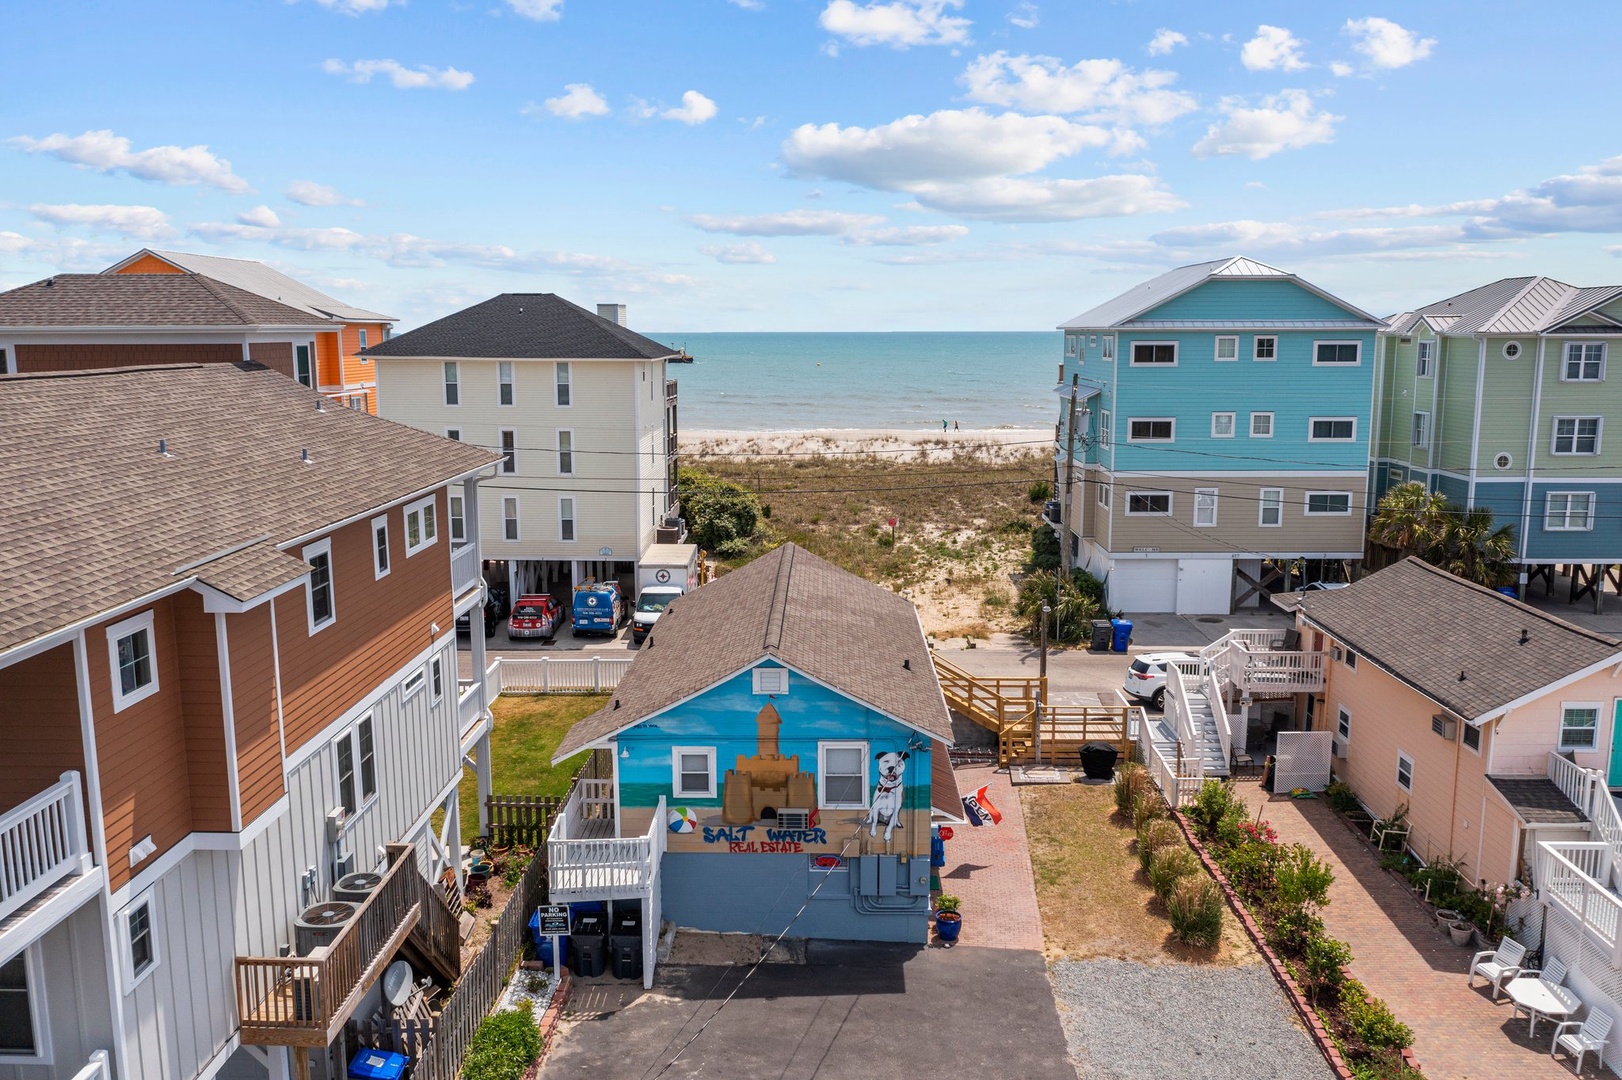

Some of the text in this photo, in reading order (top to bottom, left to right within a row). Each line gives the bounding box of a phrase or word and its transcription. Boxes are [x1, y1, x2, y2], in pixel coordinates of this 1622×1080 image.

[703, 826, 827, 844] SALT WATER
[729, 841, 803, 853] REAL ESTATE
